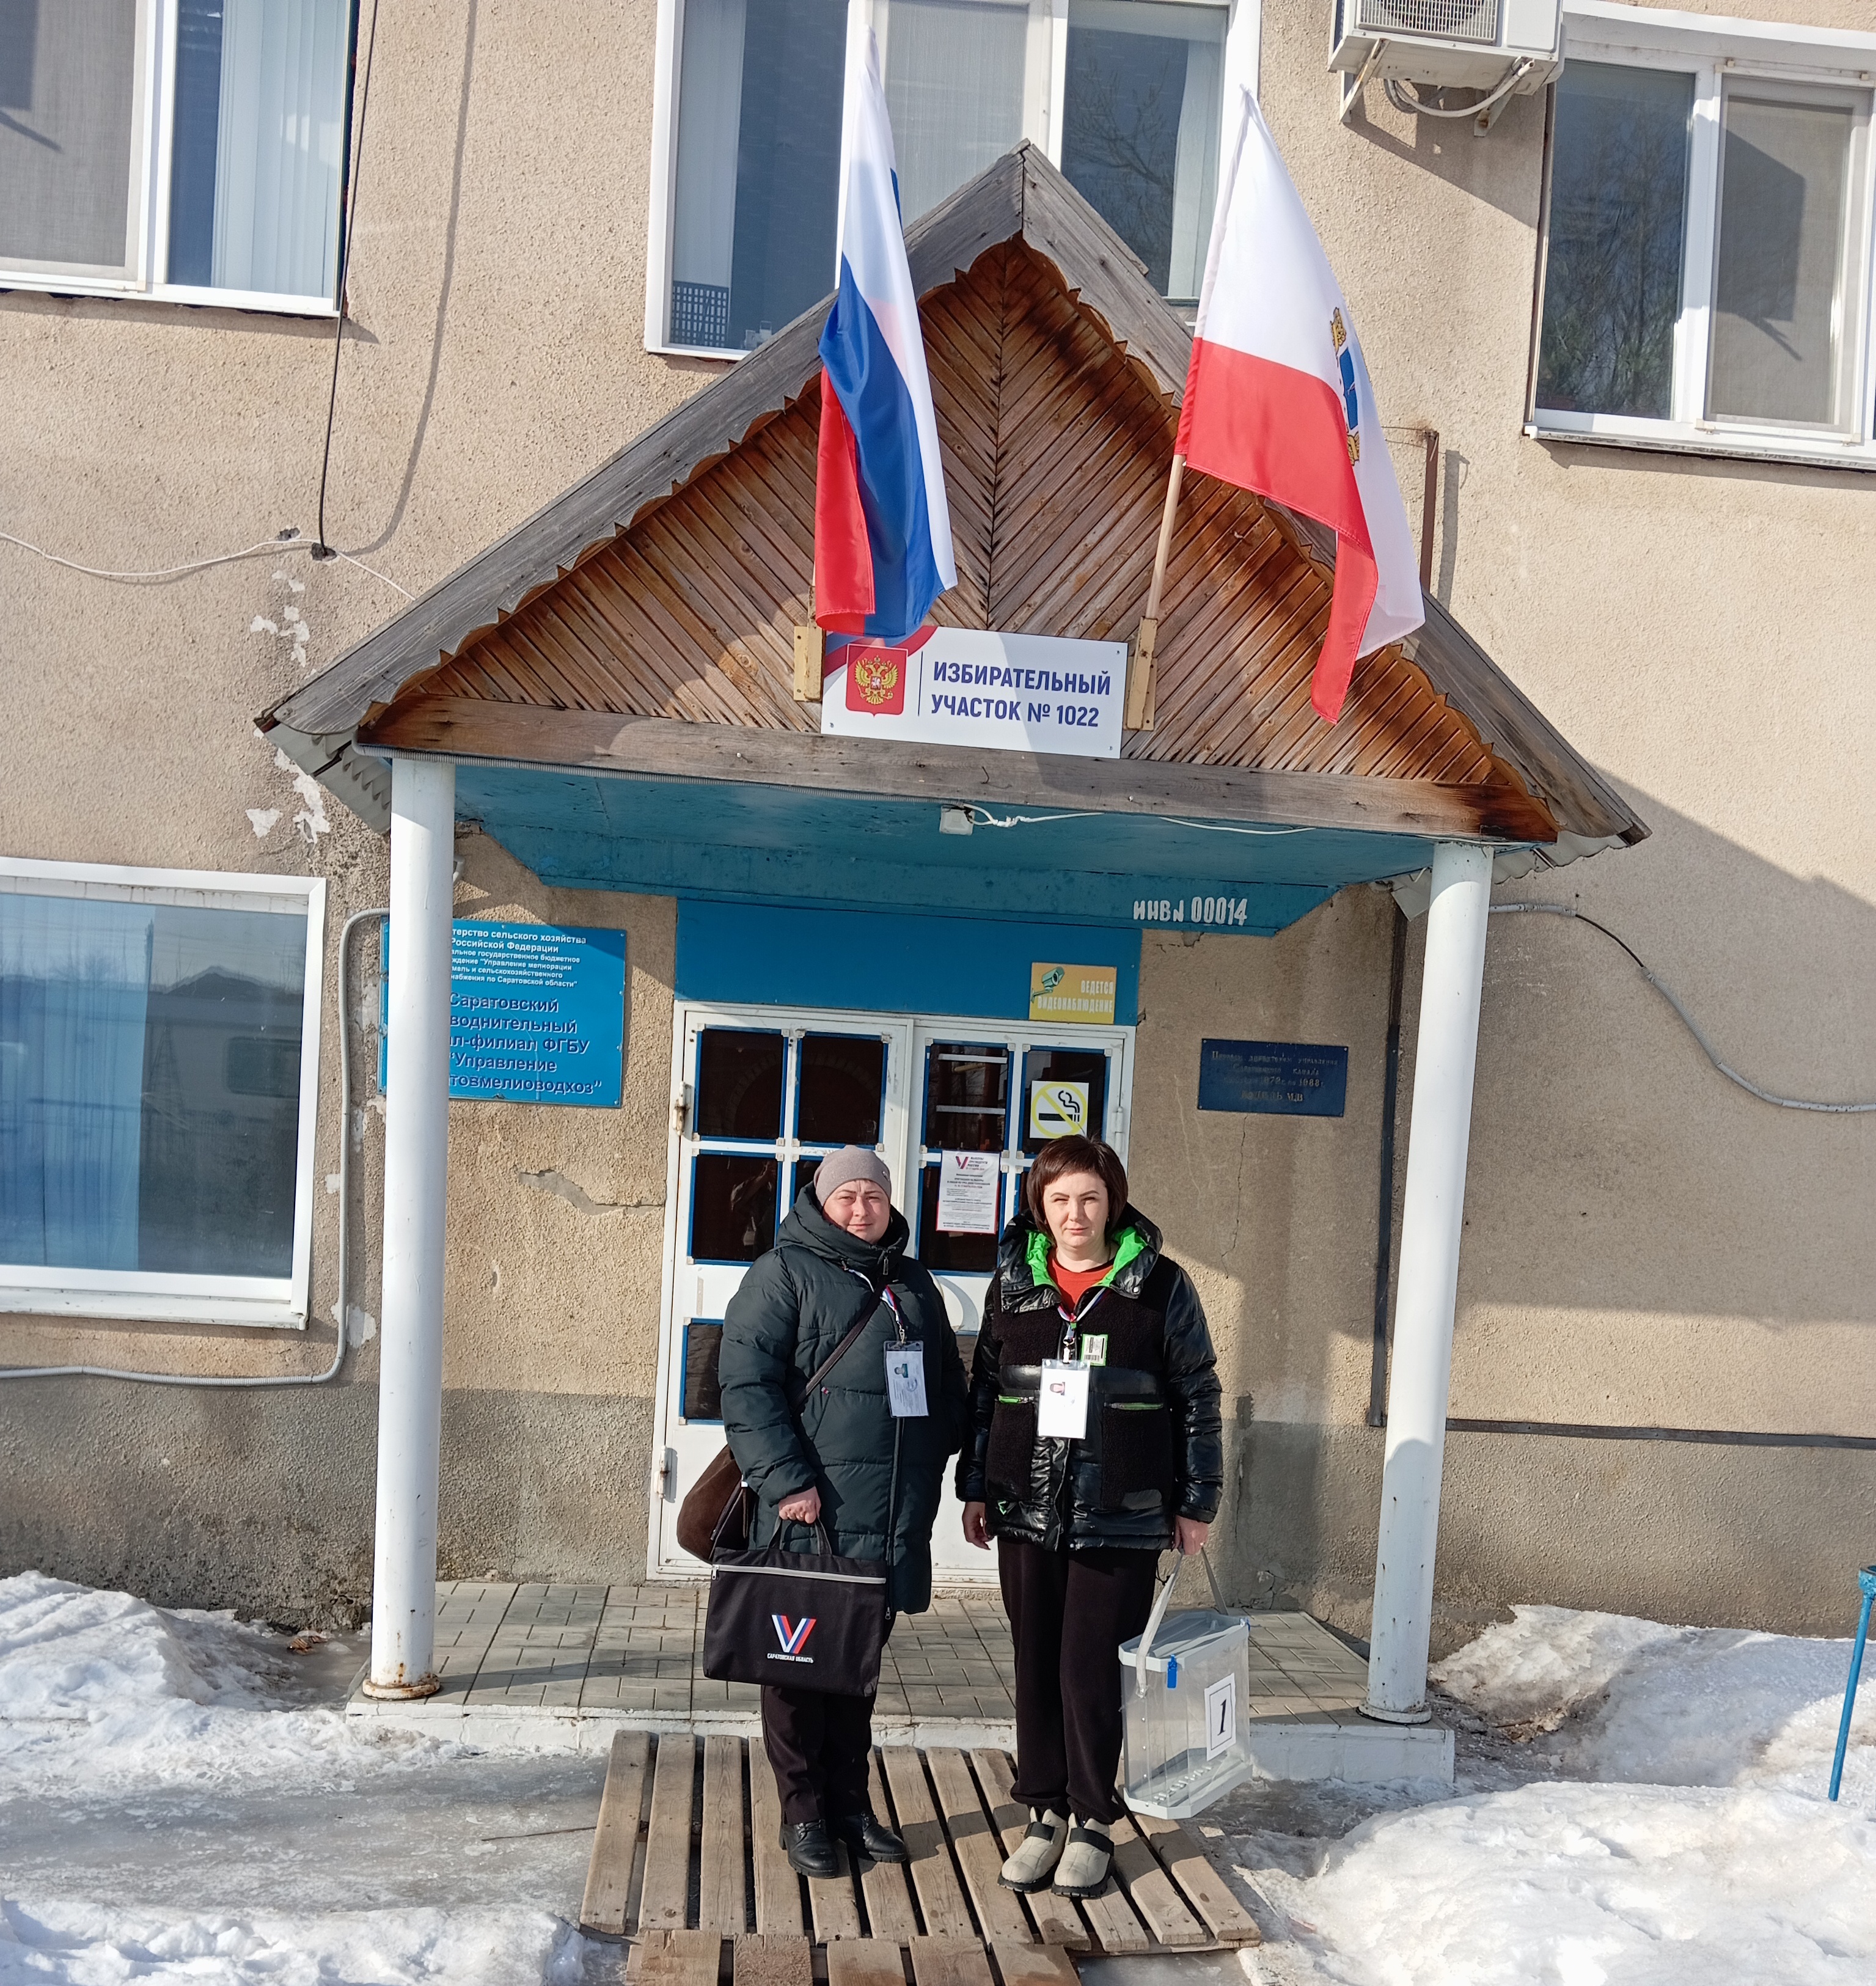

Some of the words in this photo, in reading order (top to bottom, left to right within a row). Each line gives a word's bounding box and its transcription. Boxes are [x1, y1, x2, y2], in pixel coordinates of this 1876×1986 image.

[933, 661, 1111, 695] ИЗБИРАТЕЛЬНЫЙ
[931, 694, 1022, 721] УЧАСТОК
[1027, 703, 1050, 722] №
[1057, 705, 1099, 727] 1022
[1191, 896, 1248, 926] 00014
[491, 931, 538, 941] сельского
[540, 934, 587, 944] хозяйства
[507, 942, 559, 953] Федерации
[478, 951, 539, 961] государственное
[541, 955, 581, 964] бюджетное
[478, 968, 563, 978] сельскохозяйственного
[497, 977, 543, 986] Саратовской
[1080, 980, 1114, 995] ВЕДЕТСЯ
[450, 992, 559, 1013] Саратовский
[1038, 996, 1113, 1014] ВИДЕОНАБЛЮДЕНИЕ
[542, 1036, 590, 1055] ФГБУ
[767, 1653, 795, 1662] САРАТОВСКАЯ
[1217, 1699, 1227, 1736] 1
